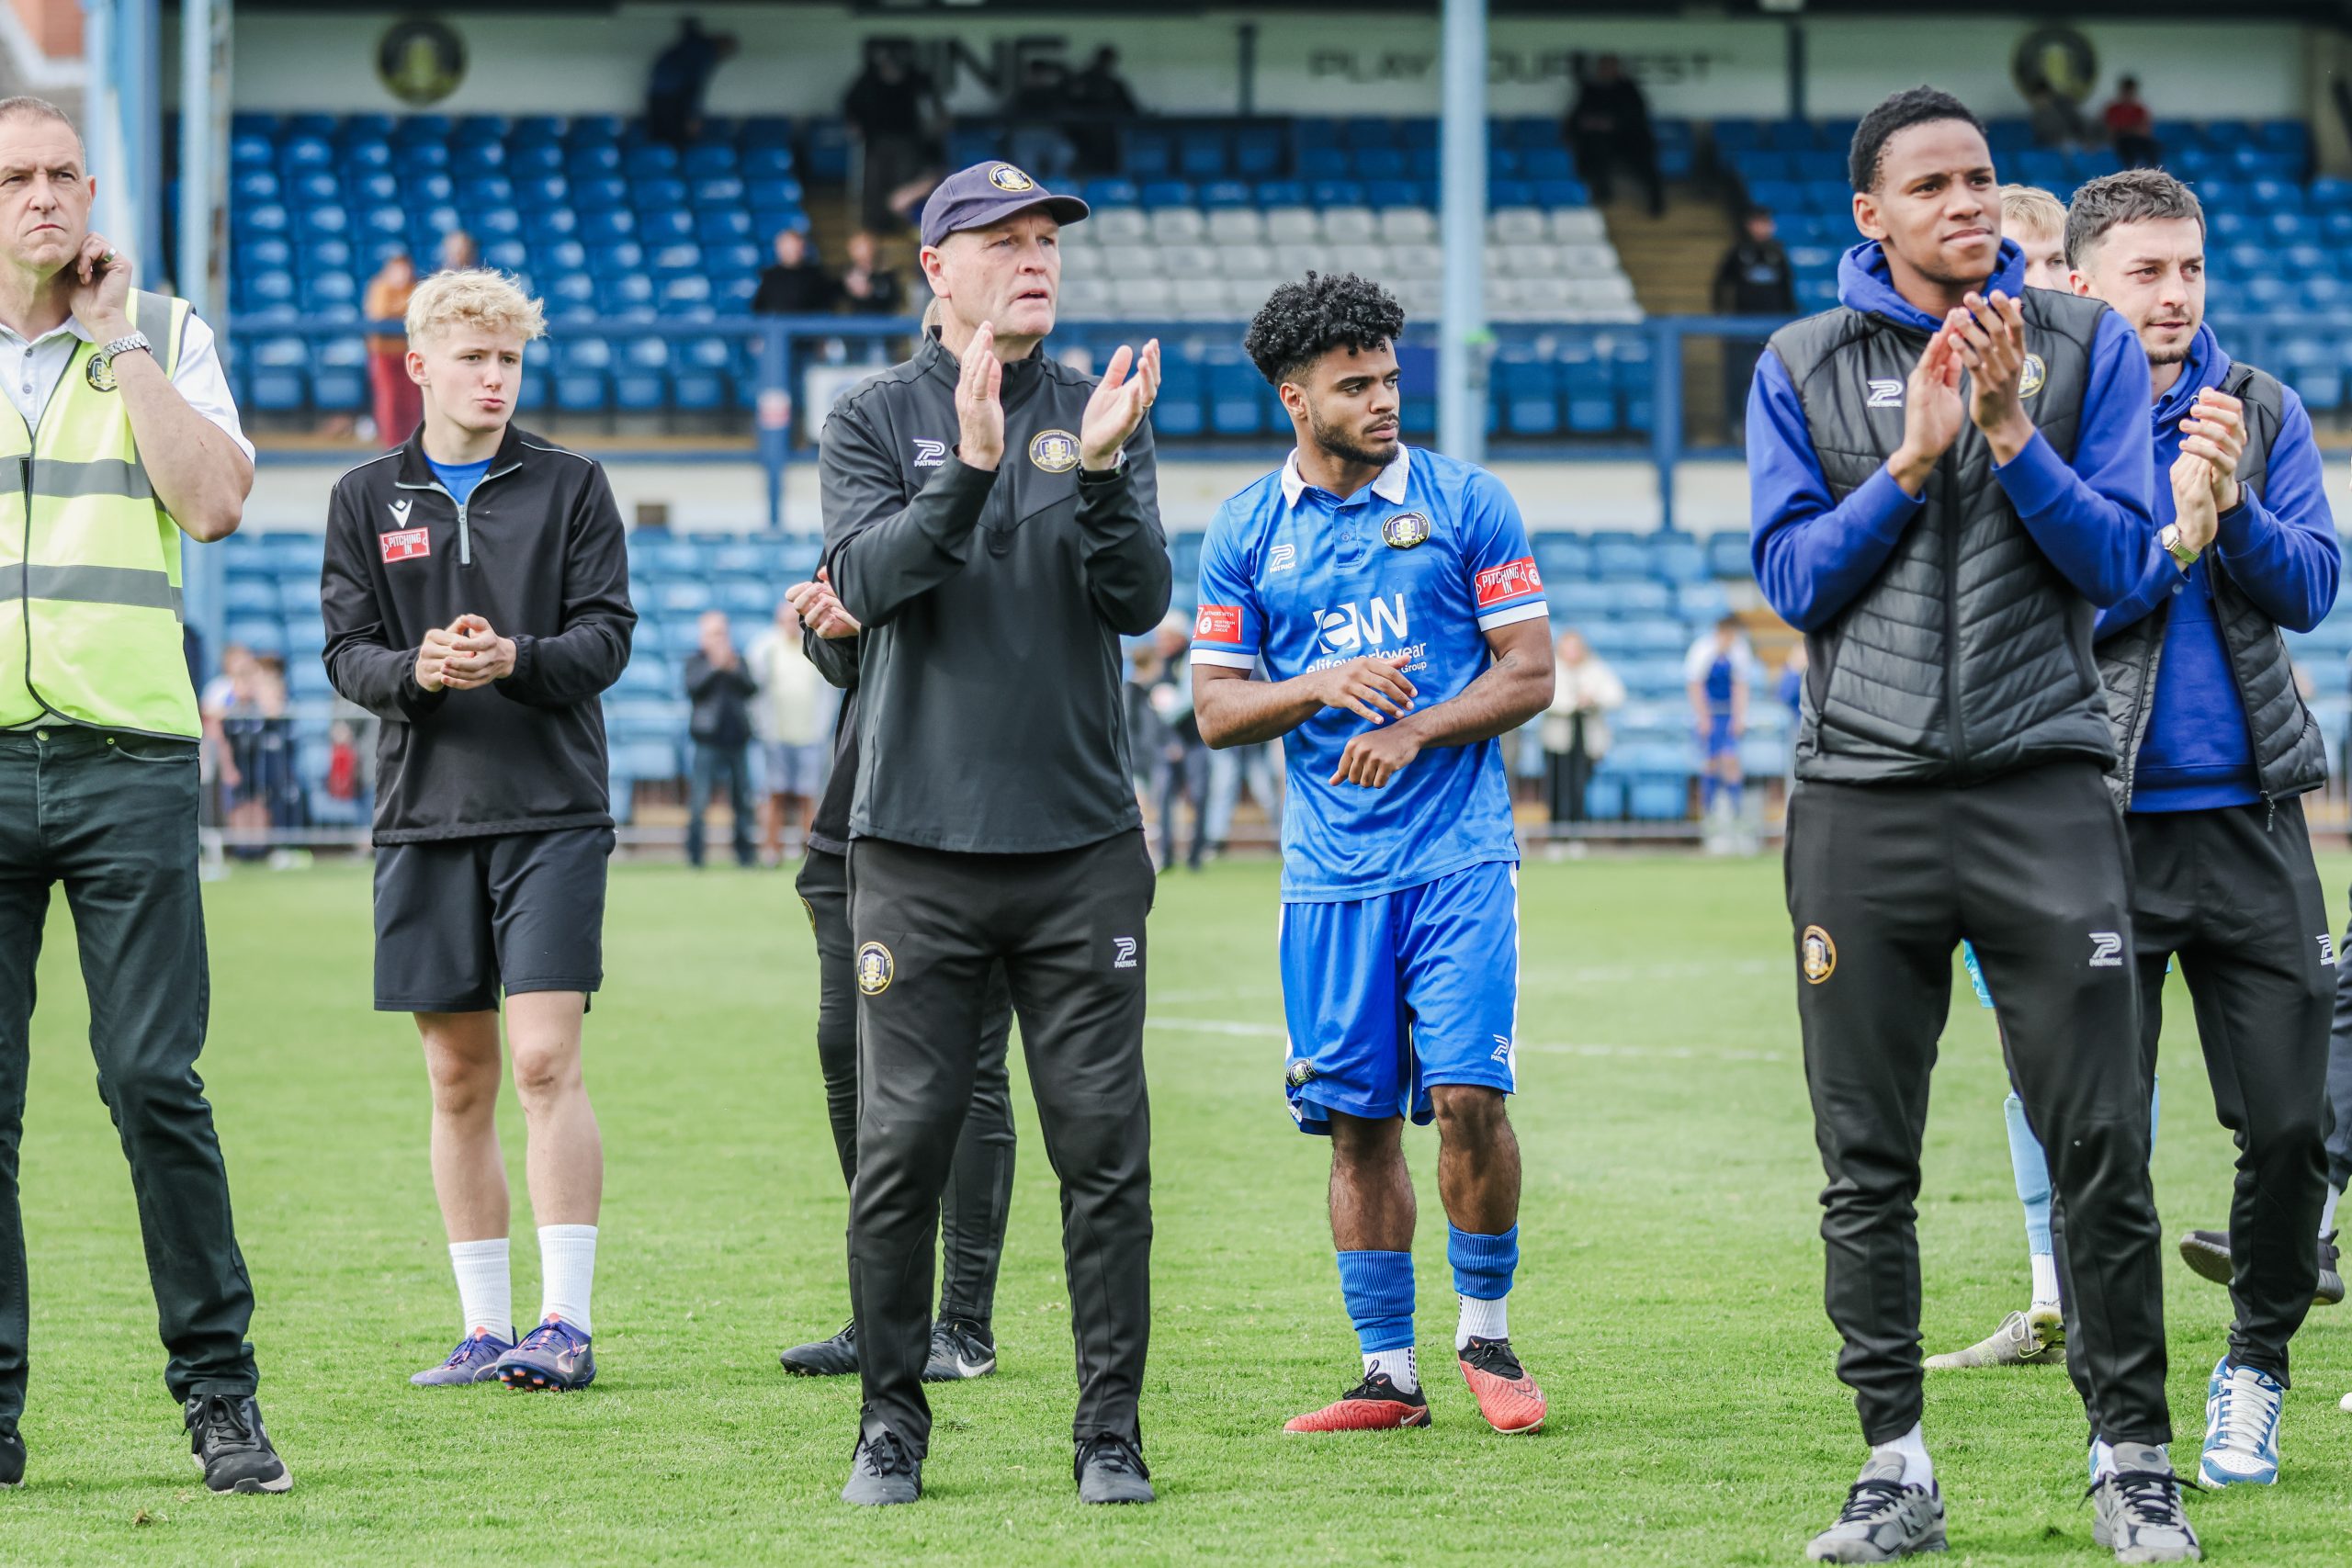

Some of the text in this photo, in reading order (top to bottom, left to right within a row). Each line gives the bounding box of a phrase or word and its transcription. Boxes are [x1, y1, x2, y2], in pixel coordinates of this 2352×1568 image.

[389, 533, 422, 547] PITCHING
[404, 543, 413, 555] IN
[1482, 566, 1520, 588] PITCHING
[1503, 580, 1513, 594] IN
[1306, 642, 1427, 674] eliterkwear
[1400, 660, 1427, 673] Group
